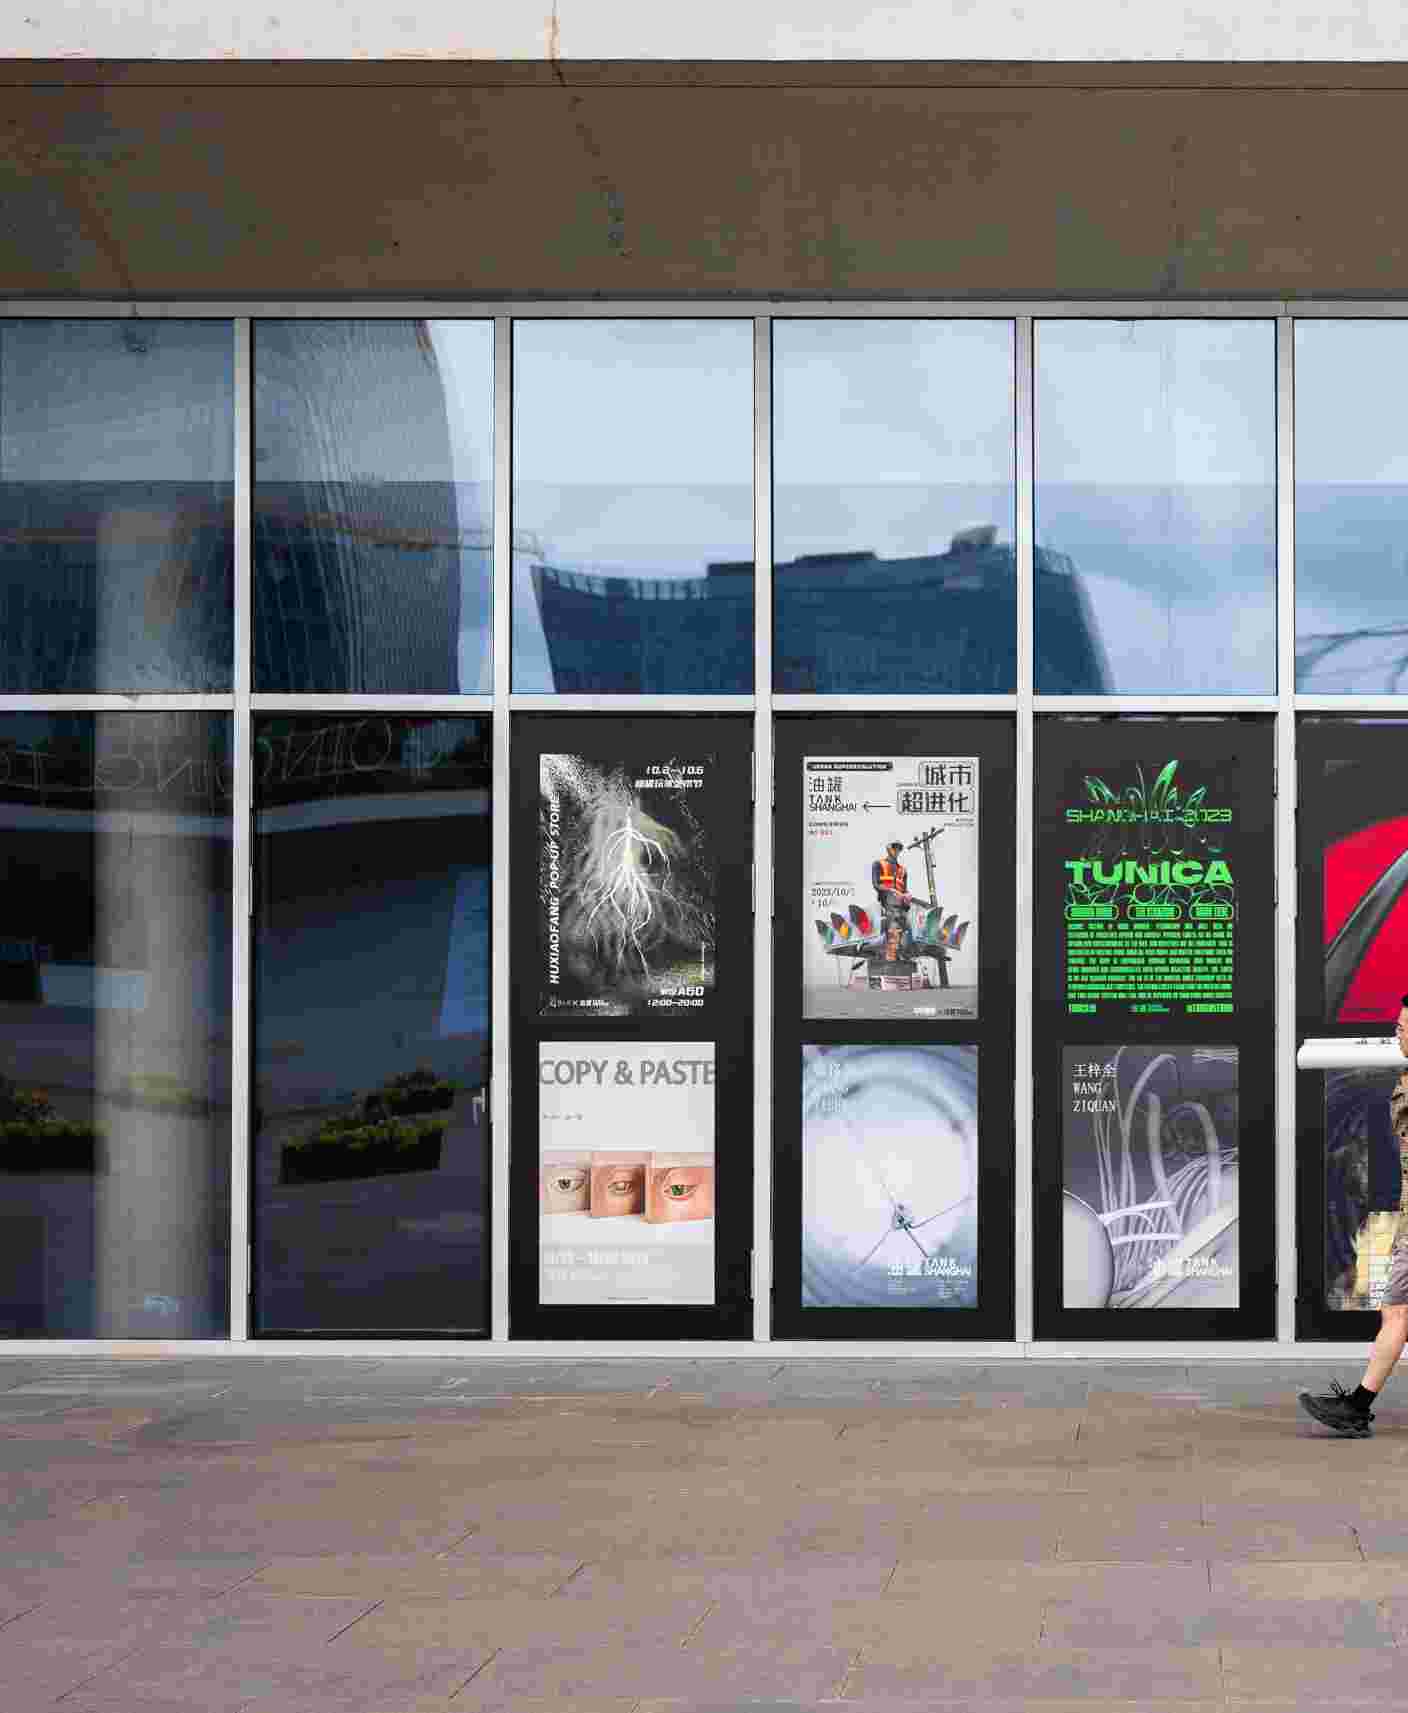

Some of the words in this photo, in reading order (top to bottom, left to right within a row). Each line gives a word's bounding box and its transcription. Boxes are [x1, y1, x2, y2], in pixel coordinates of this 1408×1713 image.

[809, 776, 842, 793] 油罐
[925, 764, 972, 785] 城市
[902, 791, 969, 813] 超进化
[1064, 860, 1233, 884] TUNICA
[550, 896, 560, 984] HUXIAOFANG
[540, 1060, 609, 1085] COPY
[614, 1060, 633, 1085] &
[640, 1060, 715, 1085] PASTE
[1072, 1083, 1102, 1094] WANG
[1072, 1100, 1116, 1112] ZIQUAN
